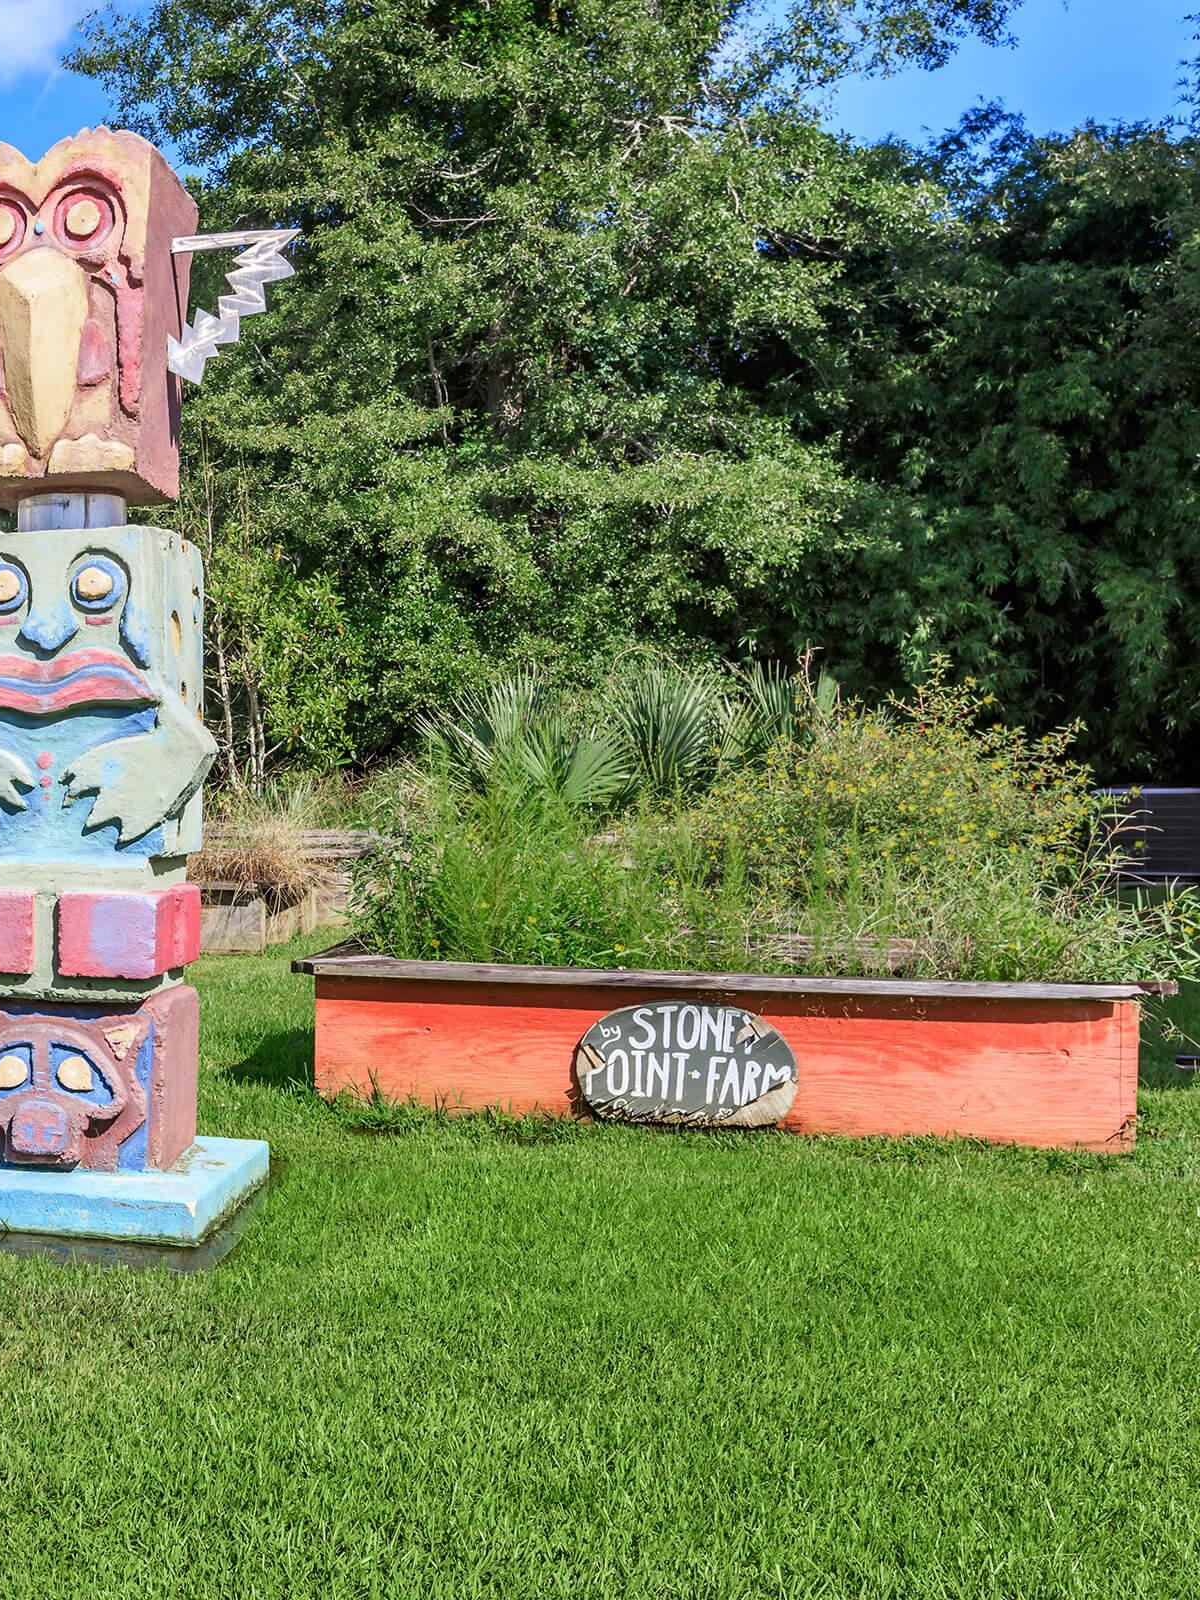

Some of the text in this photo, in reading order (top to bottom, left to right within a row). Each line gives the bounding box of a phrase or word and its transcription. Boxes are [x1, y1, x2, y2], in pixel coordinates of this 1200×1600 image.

[600, 1024, 622, 1048] by
[585, 1049, 792, 1106] POINT FARM
